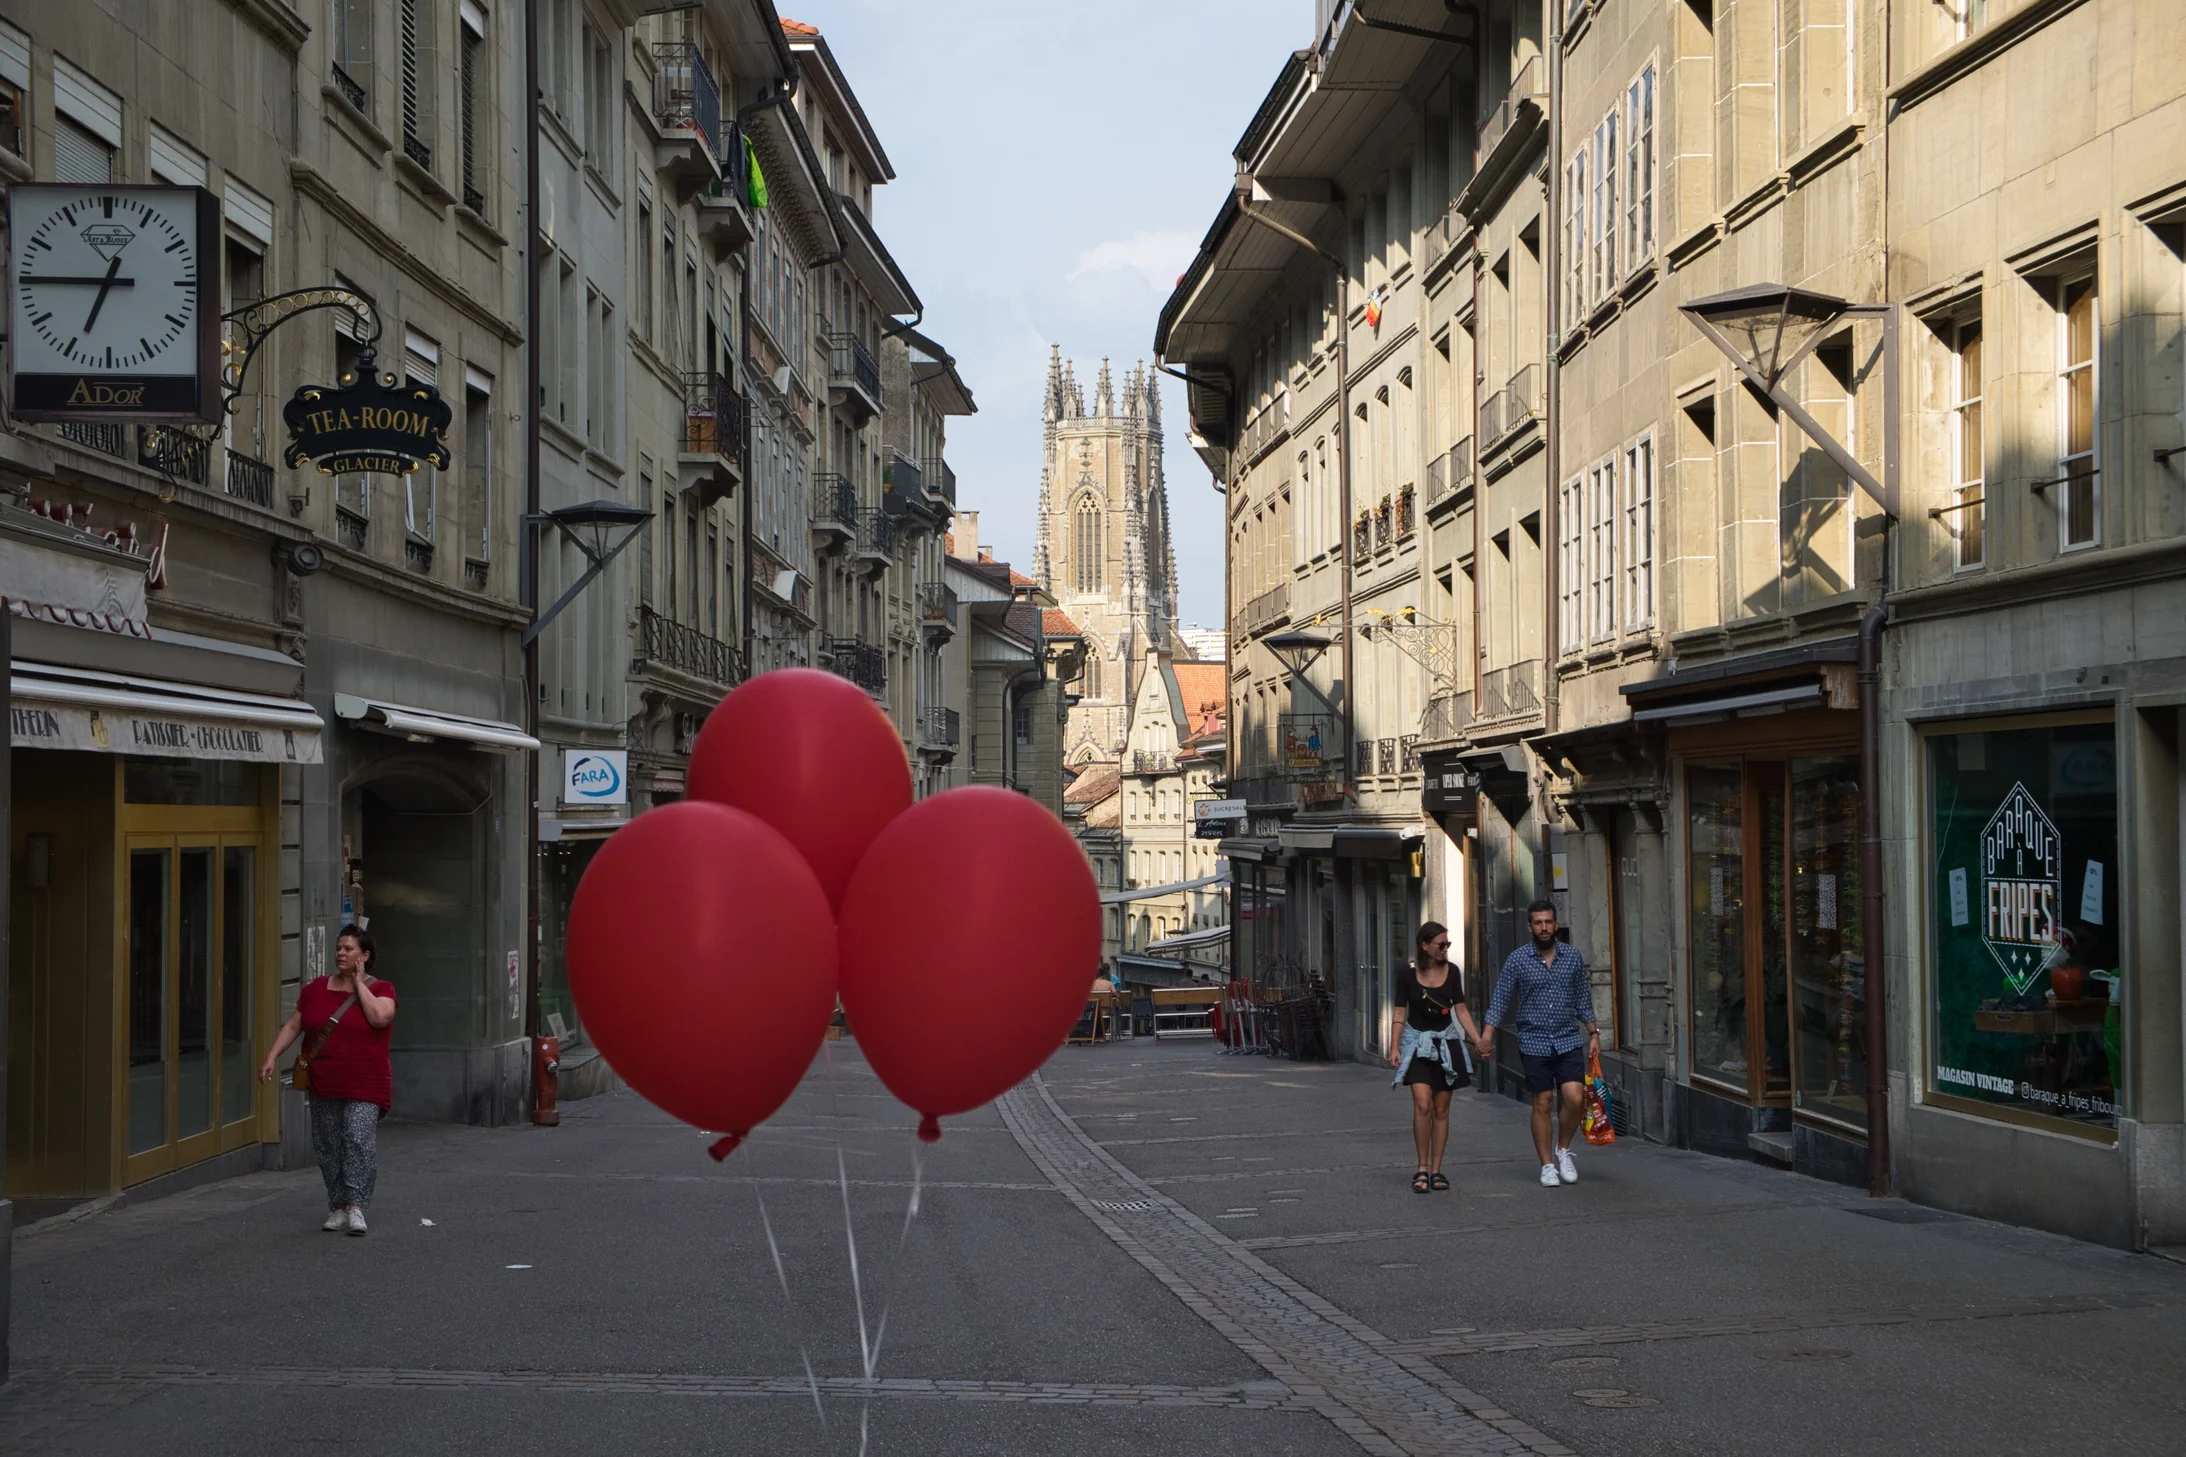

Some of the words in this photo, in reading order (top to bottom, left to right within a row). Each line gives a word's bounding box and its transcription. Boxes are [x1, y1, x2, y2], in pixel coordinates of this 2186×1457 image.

[306, 406, 429, 438] TEA-ROOM
[333, 457, 400, 473] GLACIER
[572, 769, 609, 786] FARA
[1987, 795, 2053, 877] BARAQUE
[2017, 842, 2023, 876] À
[1988, 882, 2054, 943] FRIPES
[1937, 1066, 1975, 1086] MAGASIN
[1976, 1073, 2015, 1095] VINTAGE
